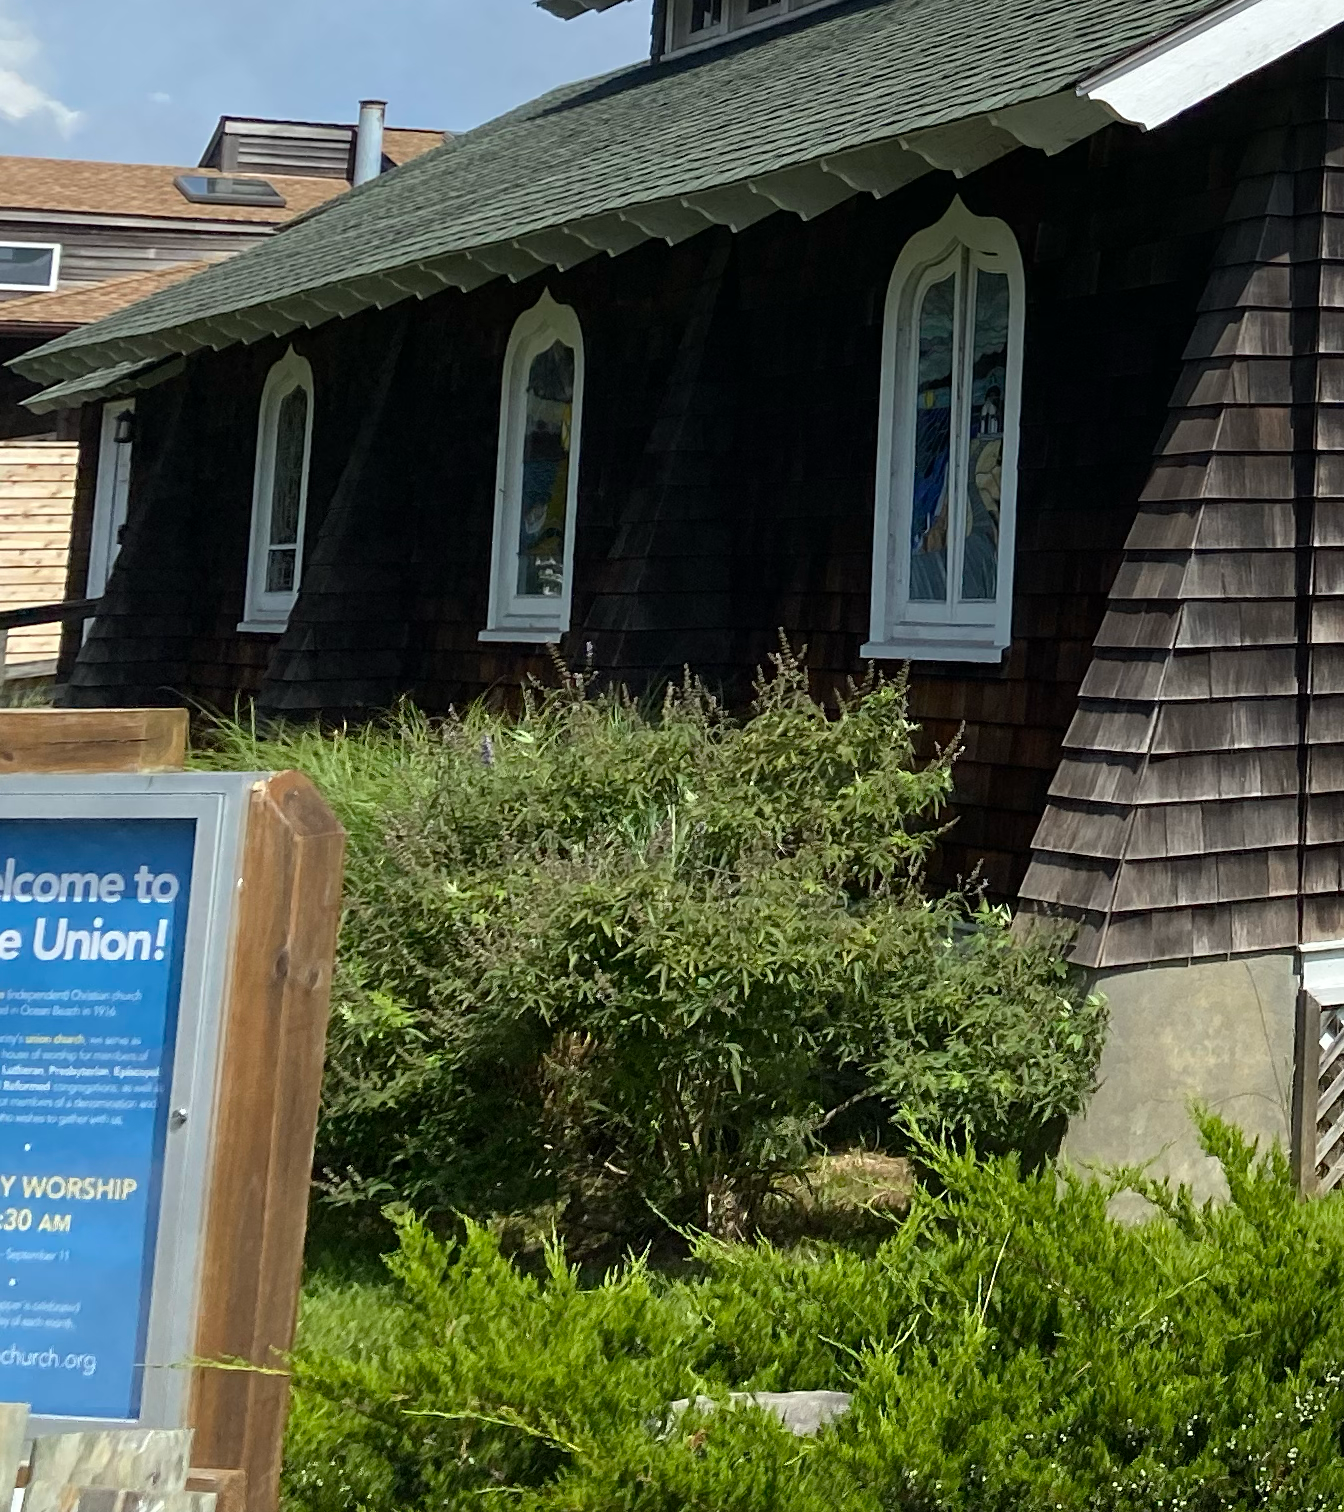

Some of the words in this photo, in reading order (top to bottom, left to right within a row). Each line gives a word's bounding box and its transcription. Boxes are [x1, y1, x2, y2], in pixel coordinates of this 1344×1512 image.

[0, 857, 125, 903] lcome
[134, 865, 180, 904] to
[33, 916, 169, 962] Union!
[22, 1175, 138, 1201] WORSHIP
[38, 1212, 72, 1232] AM
